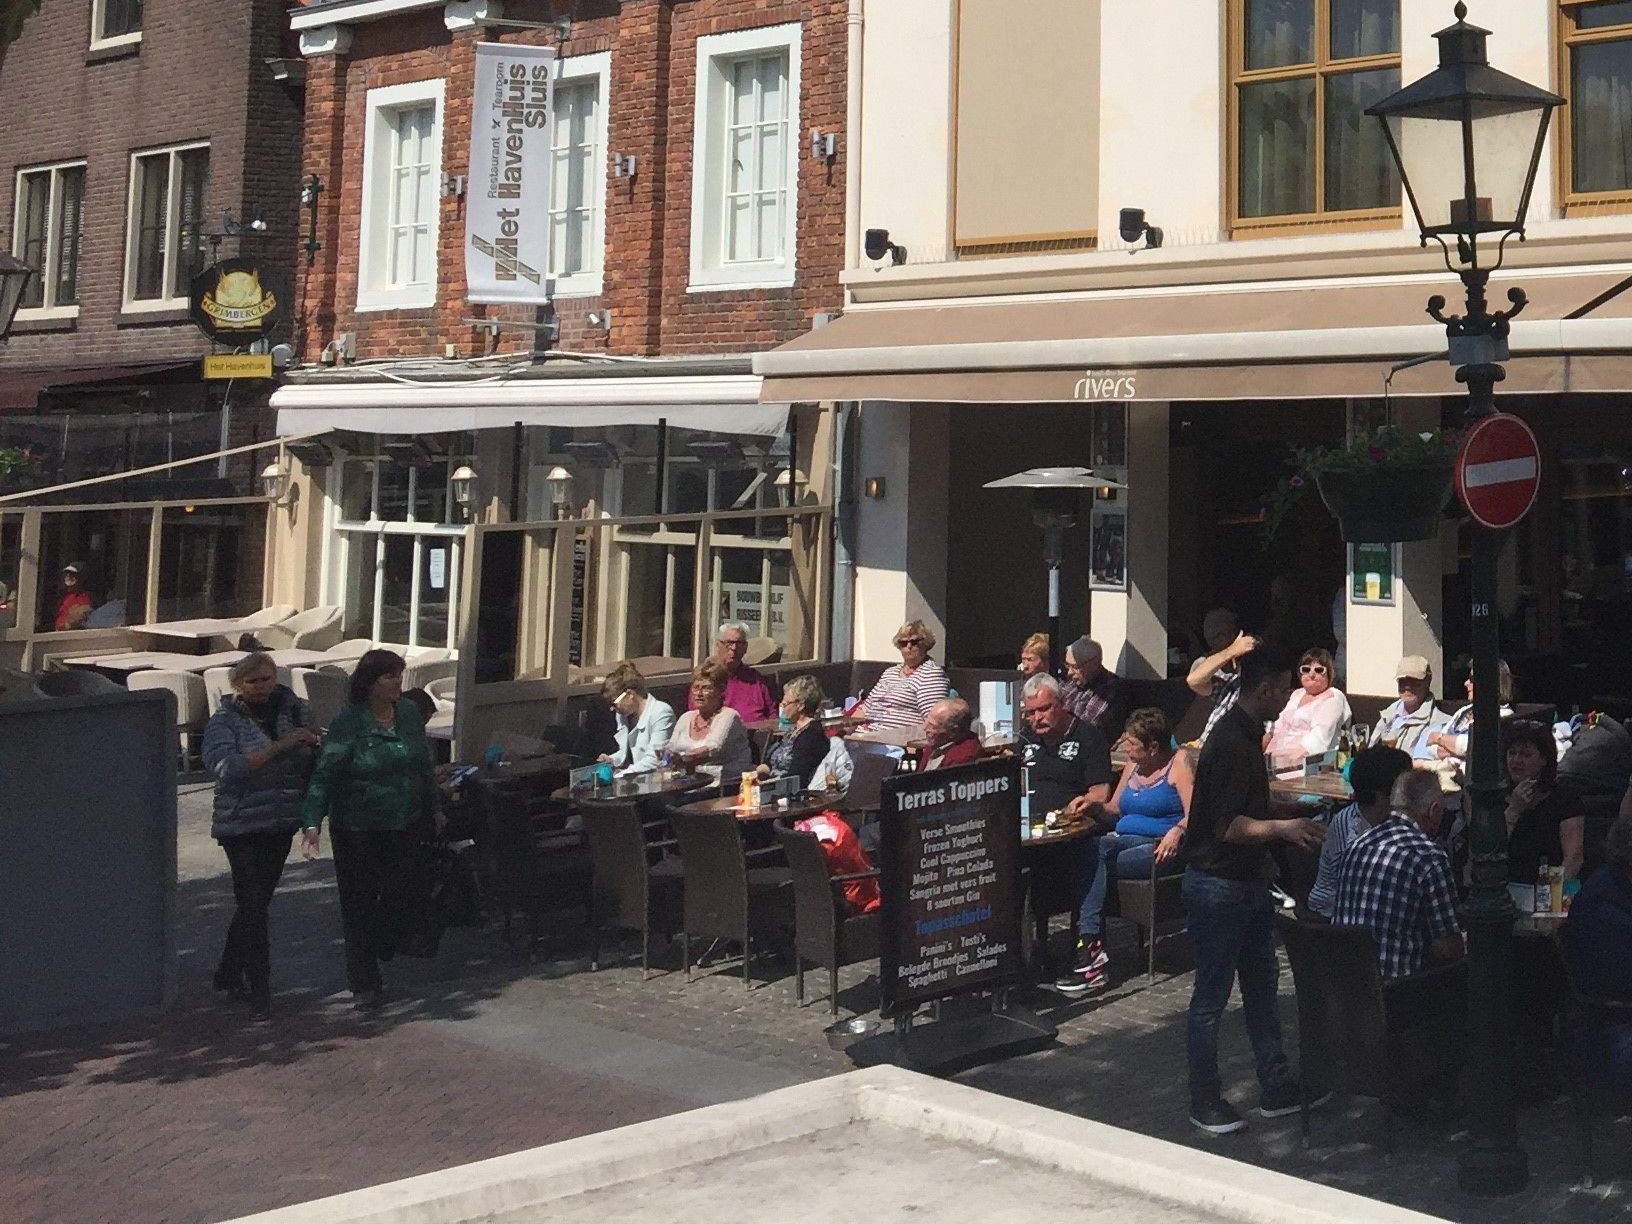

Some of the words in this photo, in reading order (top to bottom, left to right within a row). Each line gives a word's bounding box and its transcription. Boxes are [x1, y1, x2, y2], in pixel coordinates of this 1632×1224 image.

[492, 62, 504, 111] Tearoom
[525, 65, 549, 129] Sluis
[497, 63, 527, 200] HavenHuis
[488, 137, 501, 199] Restaurant
[495, 207, 520, 281] Het
[1073, 370, 1137, 399] rivers
[896, 788, 946, 812] Terras
[949, 776, 1009, 802] Toppers
[920, 828, 944, 840] Verse
[923, 840, 950, 854] Frozen
[909, 885, 941, 900] Sangria
[942, 881, 959, 892] met
[960, 878, 977, 889] vers
[913, 871, 939, 885] Mojito
[898, 960, 932, 978] Belegde
[977, 943, 1007, 958] Salades
[908, 969, 948, 988] Spaghetti
